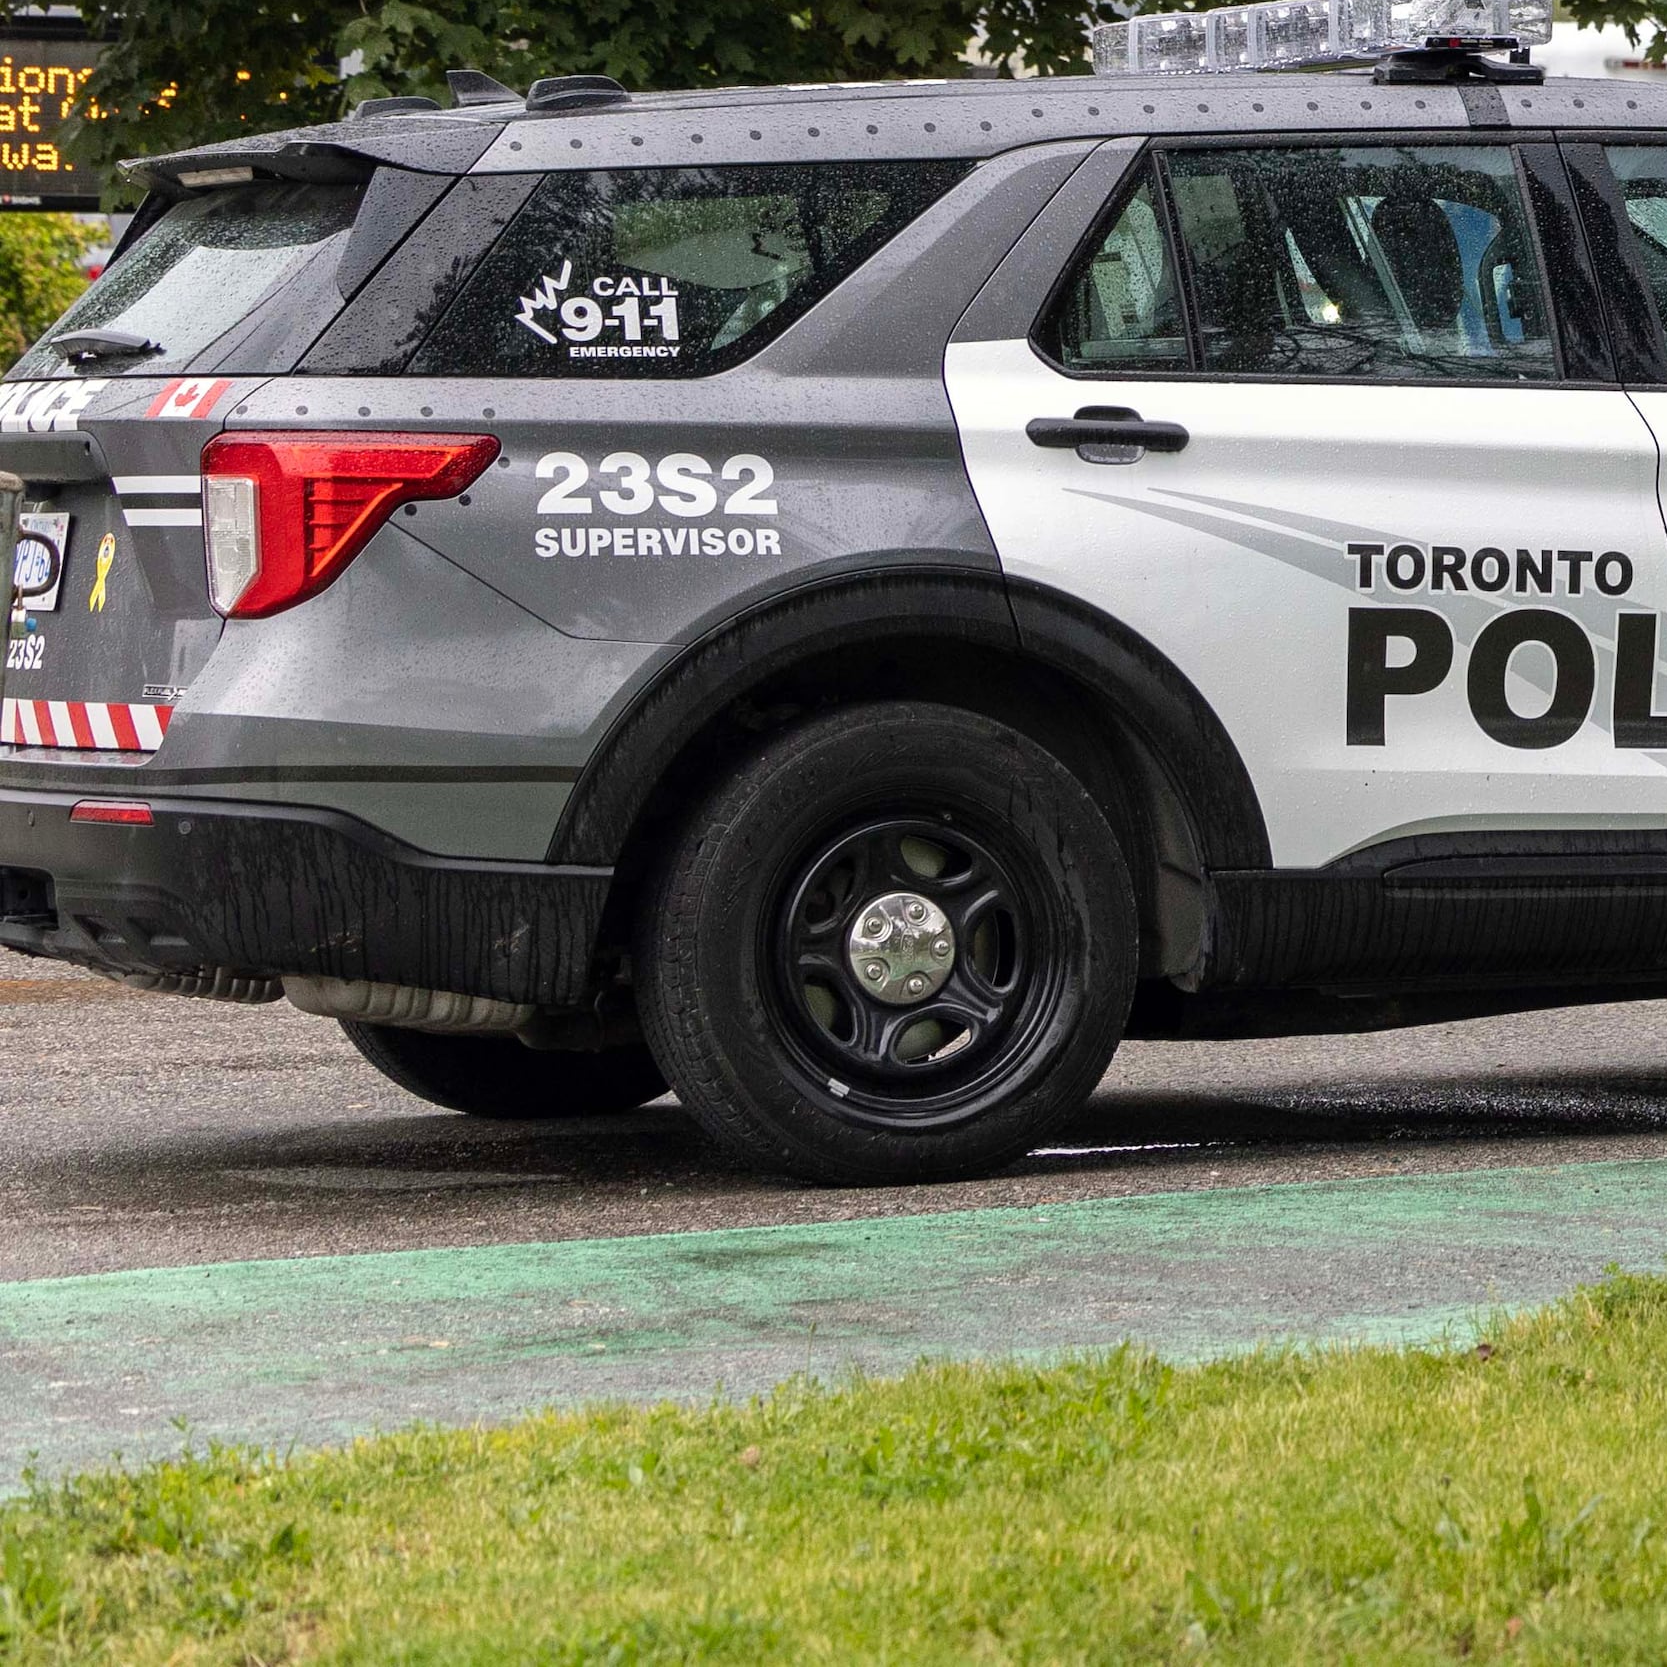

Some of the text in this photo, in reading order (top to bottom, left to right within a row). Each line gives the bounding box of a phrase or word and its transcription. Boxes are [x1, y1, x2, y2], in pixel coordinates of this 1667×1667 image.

[593, 277, 678, 296] CALL
[560, 296, 679, 342] 9-1-1
[569, 346, 680, 358] EMERGENCY
[535, 451, 778, 517] 23S2
[534, 527, 782, 557] SUPERVISOR
[1346, 542, 1634, 596] TORONTO
[6, 634, 46, 670] 23S2
